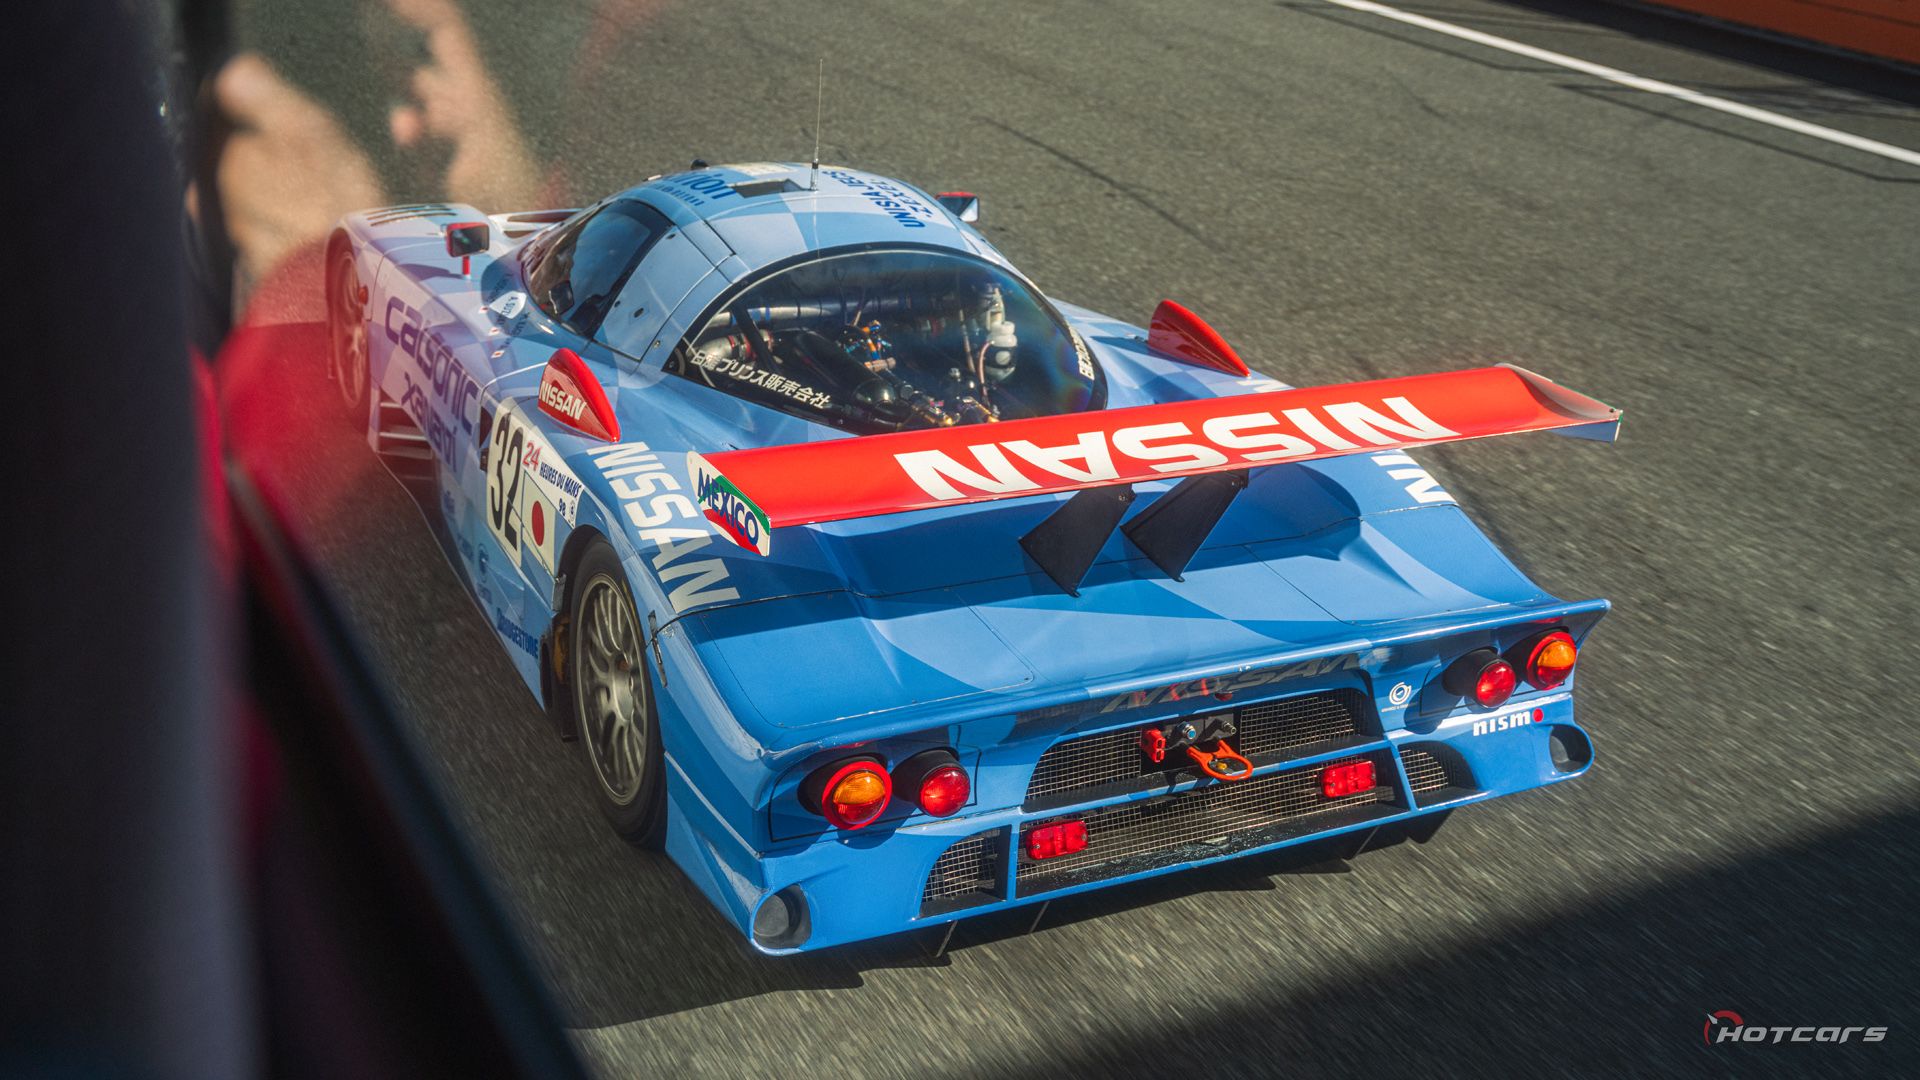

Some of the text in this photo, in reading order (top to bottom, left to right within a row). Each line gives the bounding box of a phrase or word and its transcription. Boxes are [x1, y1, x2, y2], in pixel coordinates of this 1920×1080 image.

[539, 381, 588, 421] NISSAN
[690, 349, 832, 409] 日産プリンス販売会社
[523, 442, 541, 471] 24
[893, 396, 1462, 500] NISSAN
[489, 407, 524, 552] 32
[540, 462, 559, 486] HEURES
[564, 476, 581, 498] MANS
[558, 497, 567, 517] 98
[697, 467, 760, 546] MEXICO
[585, 441, 741, 614] NISSAN
